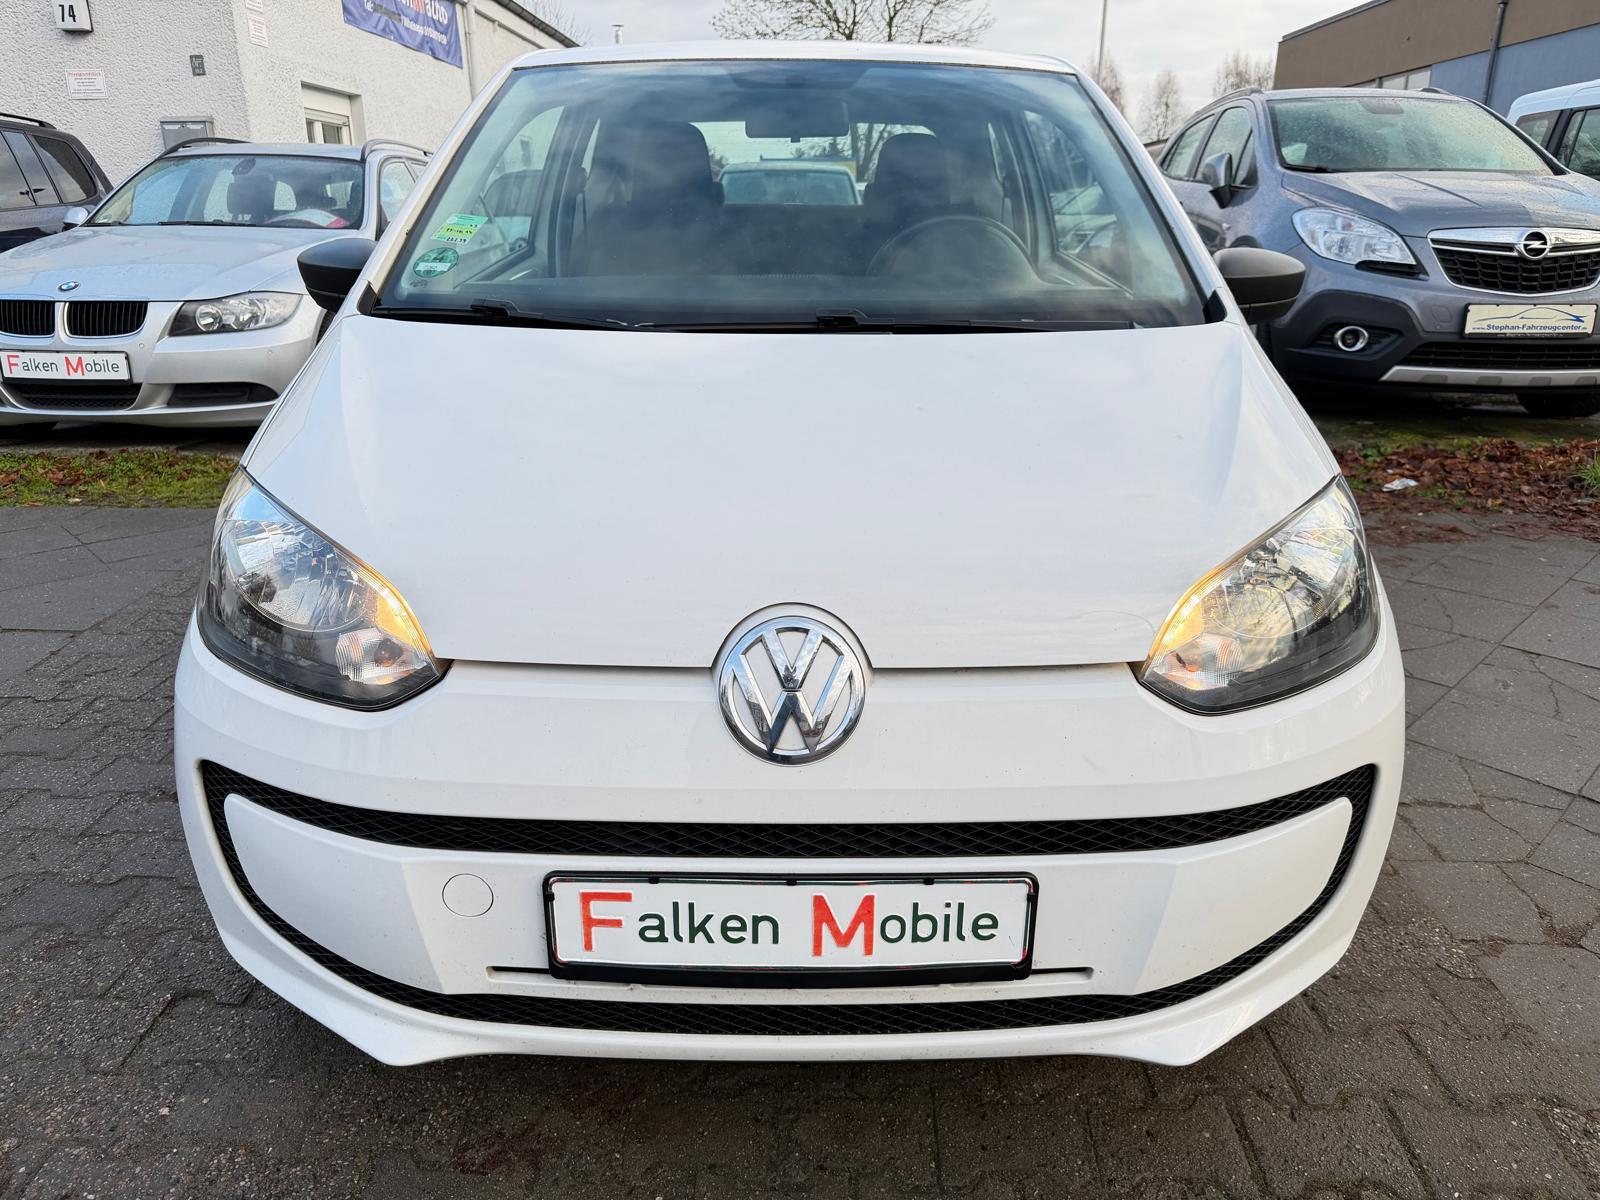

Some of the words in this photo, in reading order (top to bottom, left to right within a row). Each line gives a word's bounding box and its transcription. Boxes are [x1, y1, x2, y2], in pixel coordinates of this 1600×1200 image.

[6, 354, 59, 374] Falken
[64, 355, 120, 376] Mobile
[579, 890, 780, 953] Falken
[811, 893, 1000, 957] Mobile
